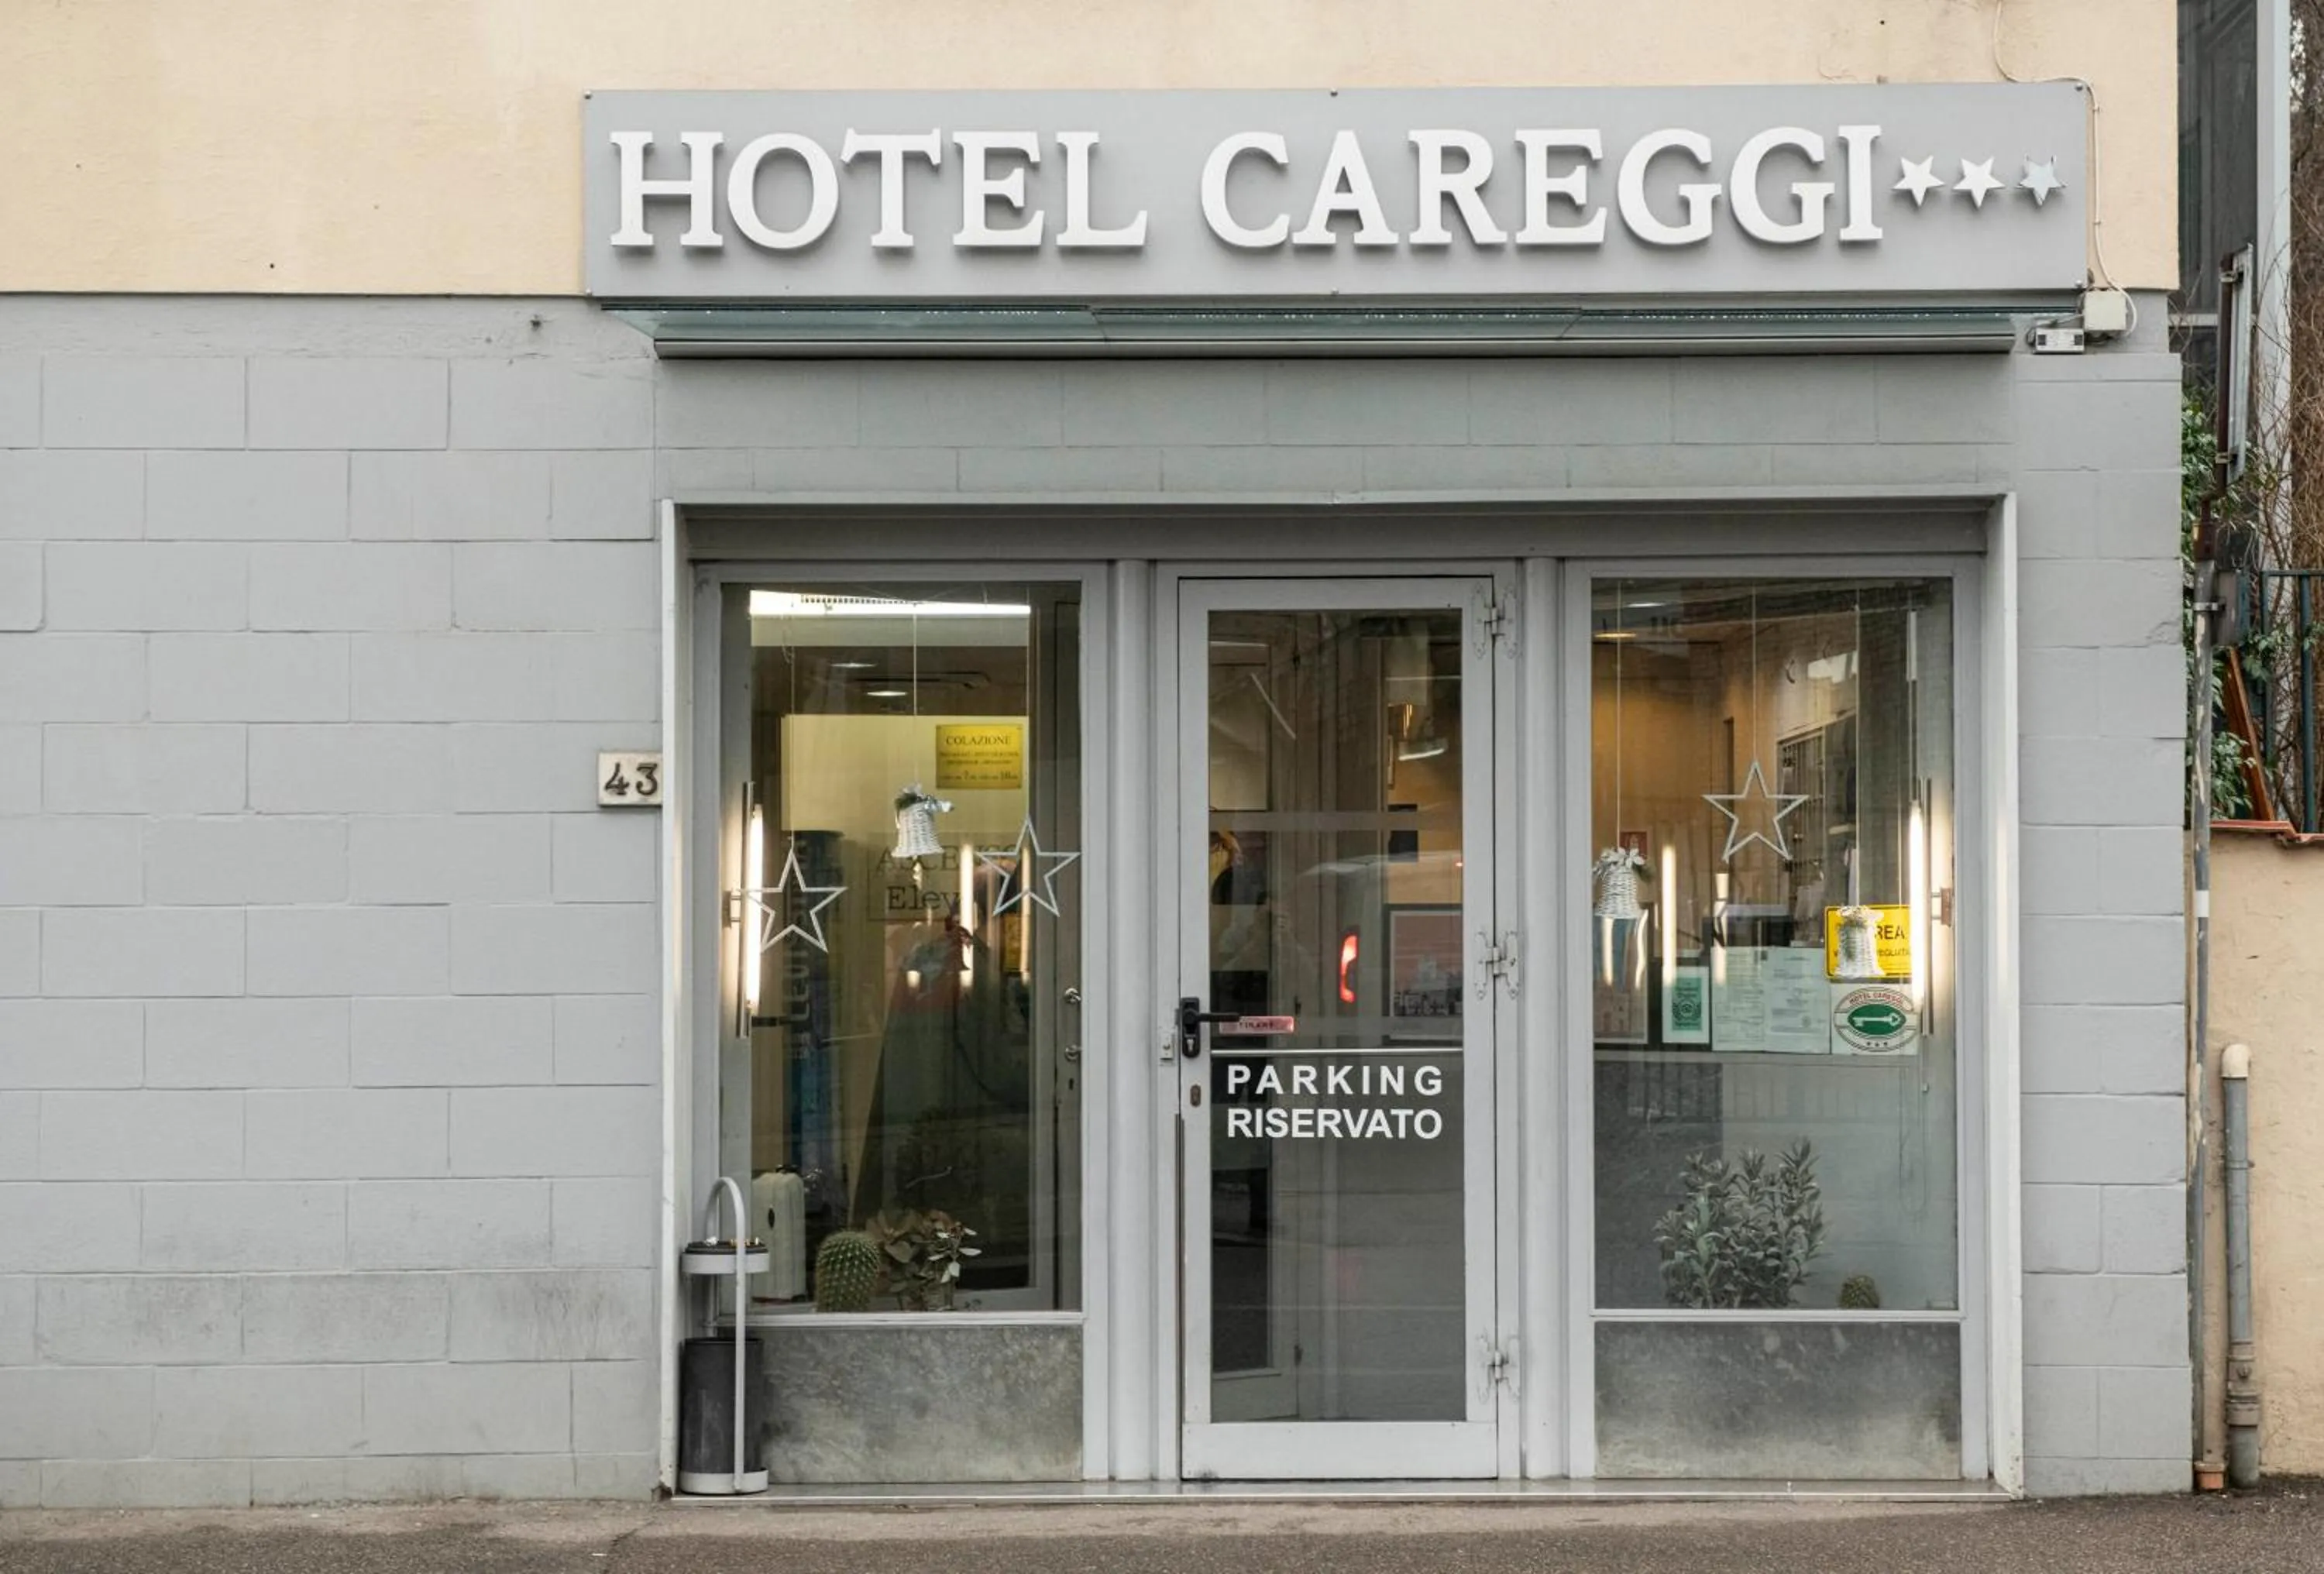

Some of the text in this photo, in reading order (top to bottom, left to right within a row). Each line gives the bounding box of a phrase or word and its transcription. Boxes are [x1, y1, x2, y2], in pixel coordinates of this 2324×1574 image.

[610, 125, 1882, 249] HOTEL CAREGGI
[604, 762, 657, 796] 43
[1874, 924, 1906, 940] REA
[1228, 1065, 1442, 1095] PARKING
[1228, 1108, 1442, 1139] RISERVATO
